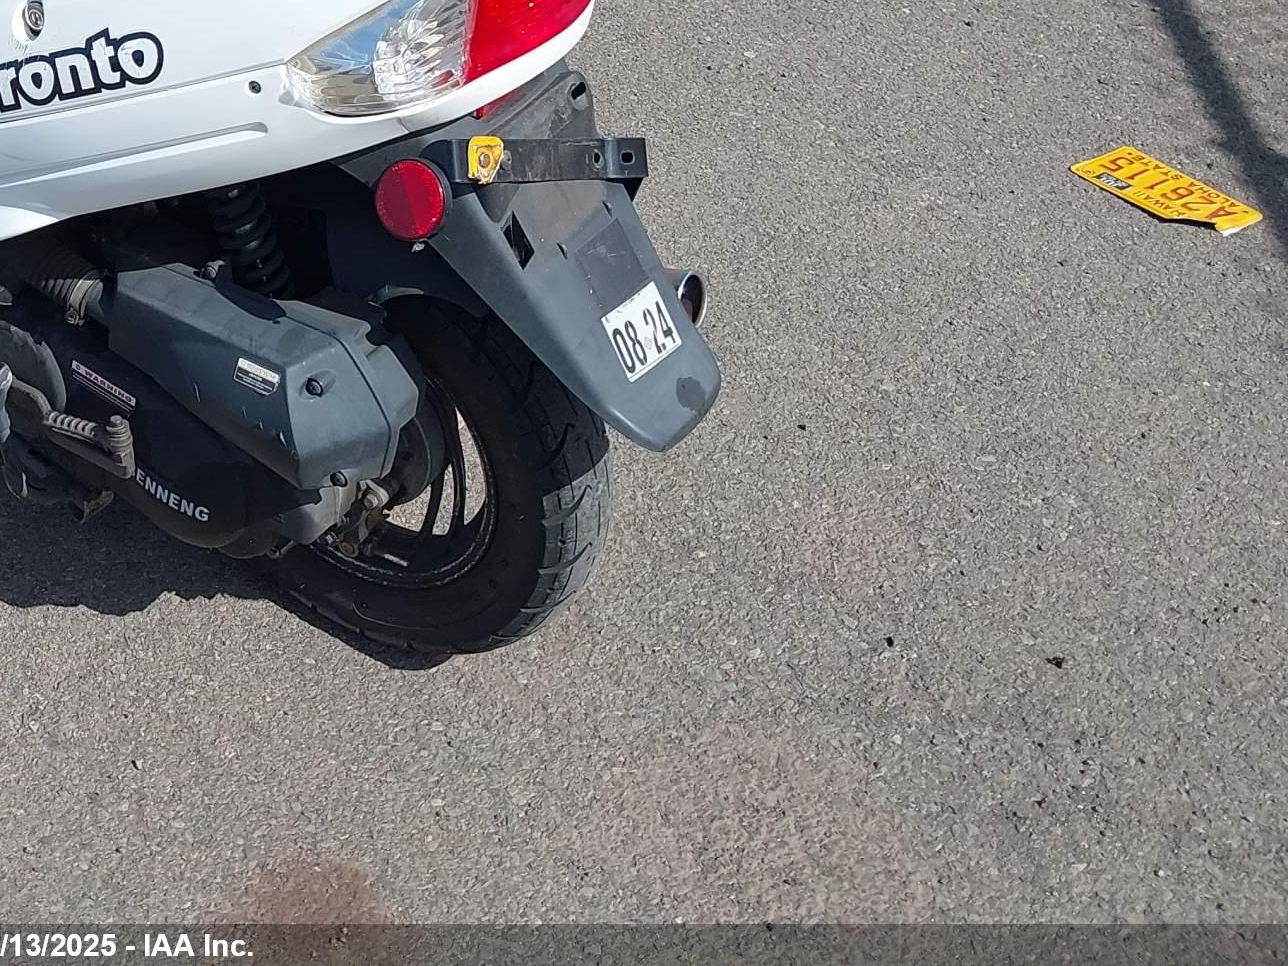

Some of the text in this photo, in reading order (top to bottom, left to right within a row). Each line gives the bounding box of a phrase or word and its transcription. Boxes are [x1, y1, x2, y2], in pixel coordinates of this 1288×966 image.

[1100, 155, 1238, 220] A26115
[1132, 155, 1240, 208] ALOHA STATE
[1132, 190, 1186, 218] HAWAII
[612, 320, 648, 374] 08
[643, 300, 676, 355] 24
[84, 369, 132, 403] WARNING
[135, 467, 211, 522] ENNENG
